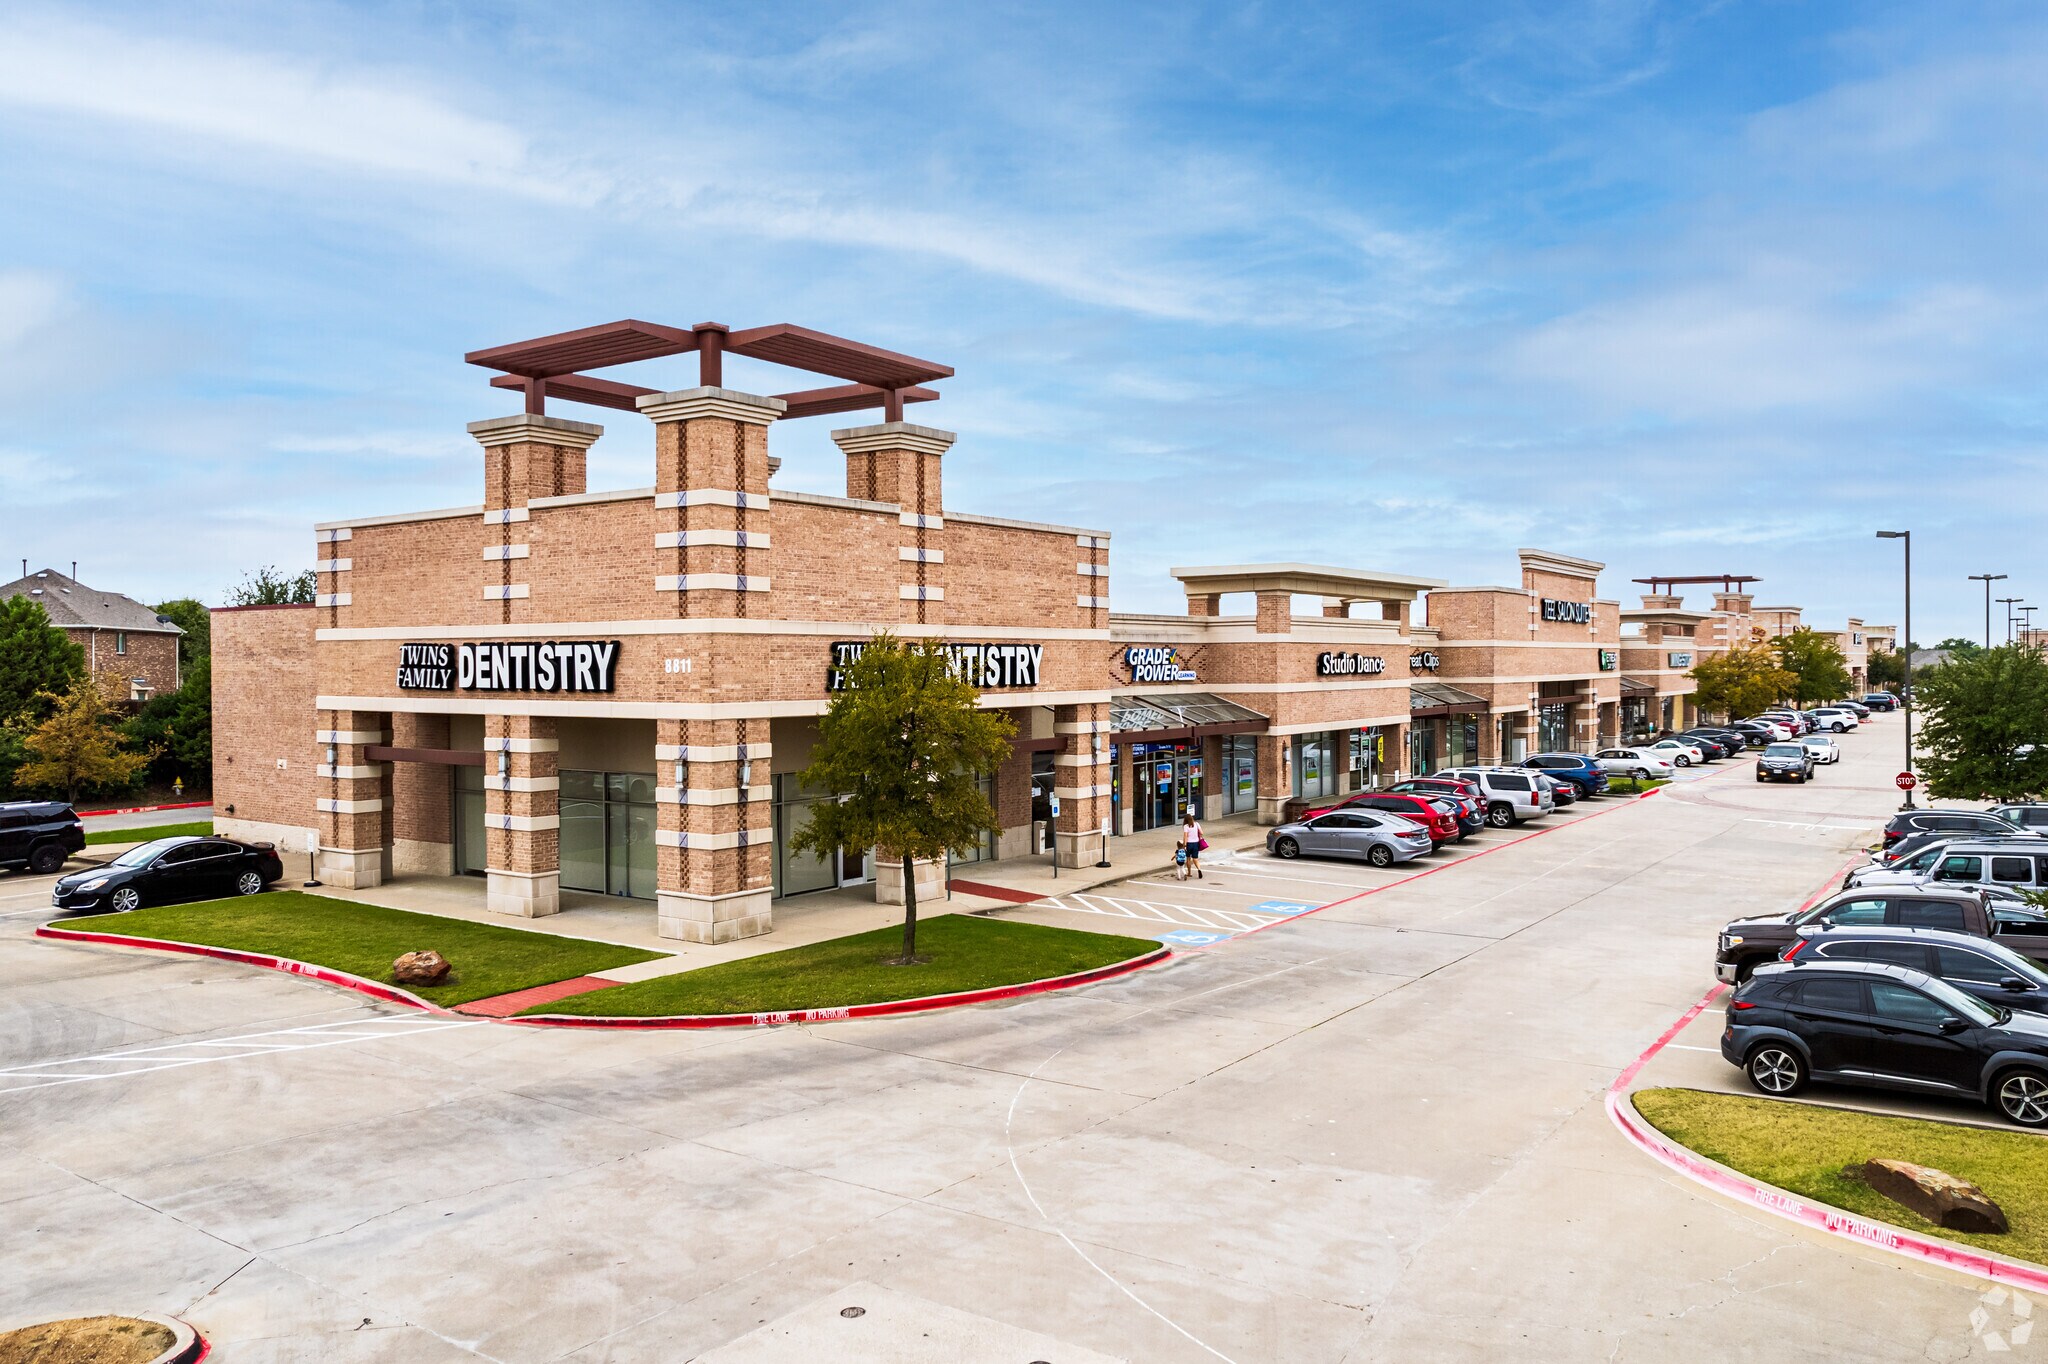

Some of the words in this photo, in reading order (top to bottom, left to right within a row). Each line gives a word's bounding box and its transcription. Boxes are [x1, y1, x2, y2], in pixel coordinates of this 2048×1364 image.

[399, 645, 449, 667] TWINS
[665, 658, 692, 674] 8811
[1129, 648, 1171, 666] GRADE
[1322, 652, 1354, 674] Studio
[1357, 655, 1386, 674] Dance
[1410, 655, 1422, 667] reat
[458, 644, 614, 690] DENTISTRY
[1135, 664, 1179, 682] POWER
[396, 668, 452, 690] FAMILY
[771, 1013, 790, 1023] LANE
[805, 1010, 817, 1020] NO
[818, 1008, 849, 1019] PARKING
[1754, 1188, 1775, 1206] FIRE
[1775, 1195, 1804, 1216] LANE
[1825, 1212, 1842, 1228] NO
[1845, 1217, 1898, 1247] PARKING
